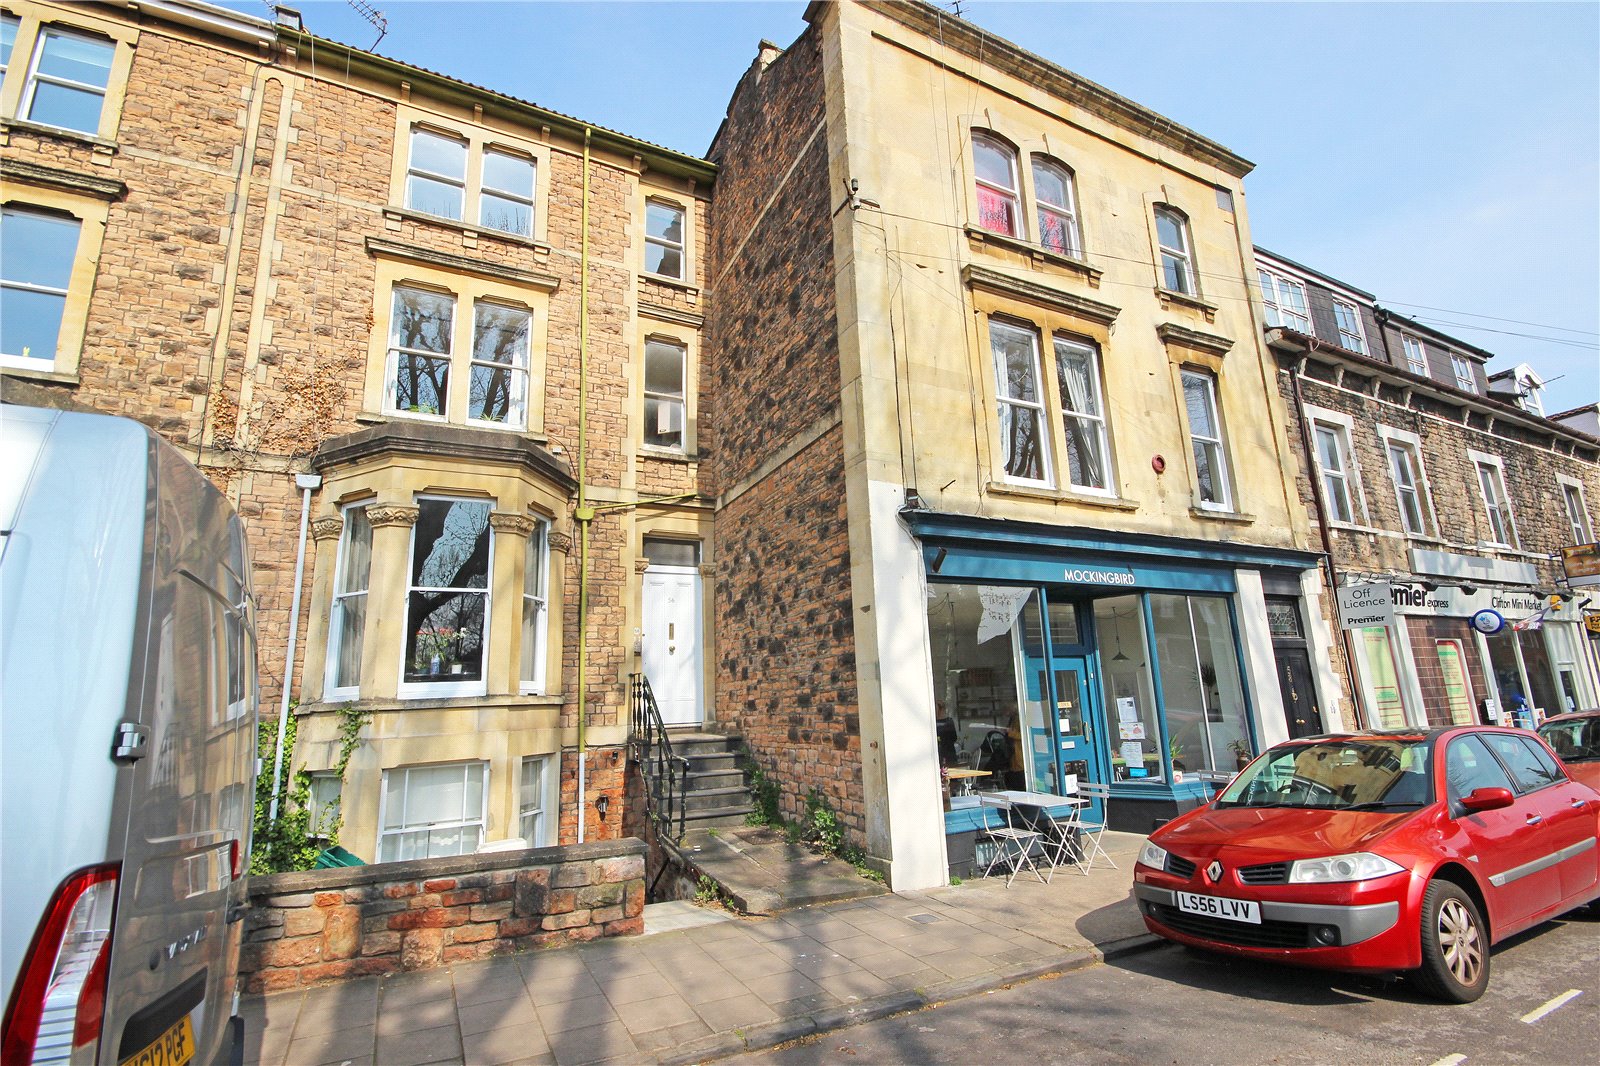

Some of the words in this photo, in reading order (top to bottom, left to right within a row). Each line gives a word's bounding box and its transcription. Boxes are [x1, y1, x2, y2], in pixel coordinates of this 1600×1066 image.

[1064, 568, 1135, 585] MOCKINGBIRD
[1352, 588, 1371, 599] Off
[1343, 598, 1386, 609] Licence
[1427, 600, 1449, 611] express
[1491, 596, 1511, 608] Clifton
[1511, 598, 1523, 609] Mini
[1524, 599, 1543, 611] Market
[1347, 615, 1386, 625] Premier
[1181, 894, 1217, 914] LS56
[1221, 900, 1250, 919] LVV
